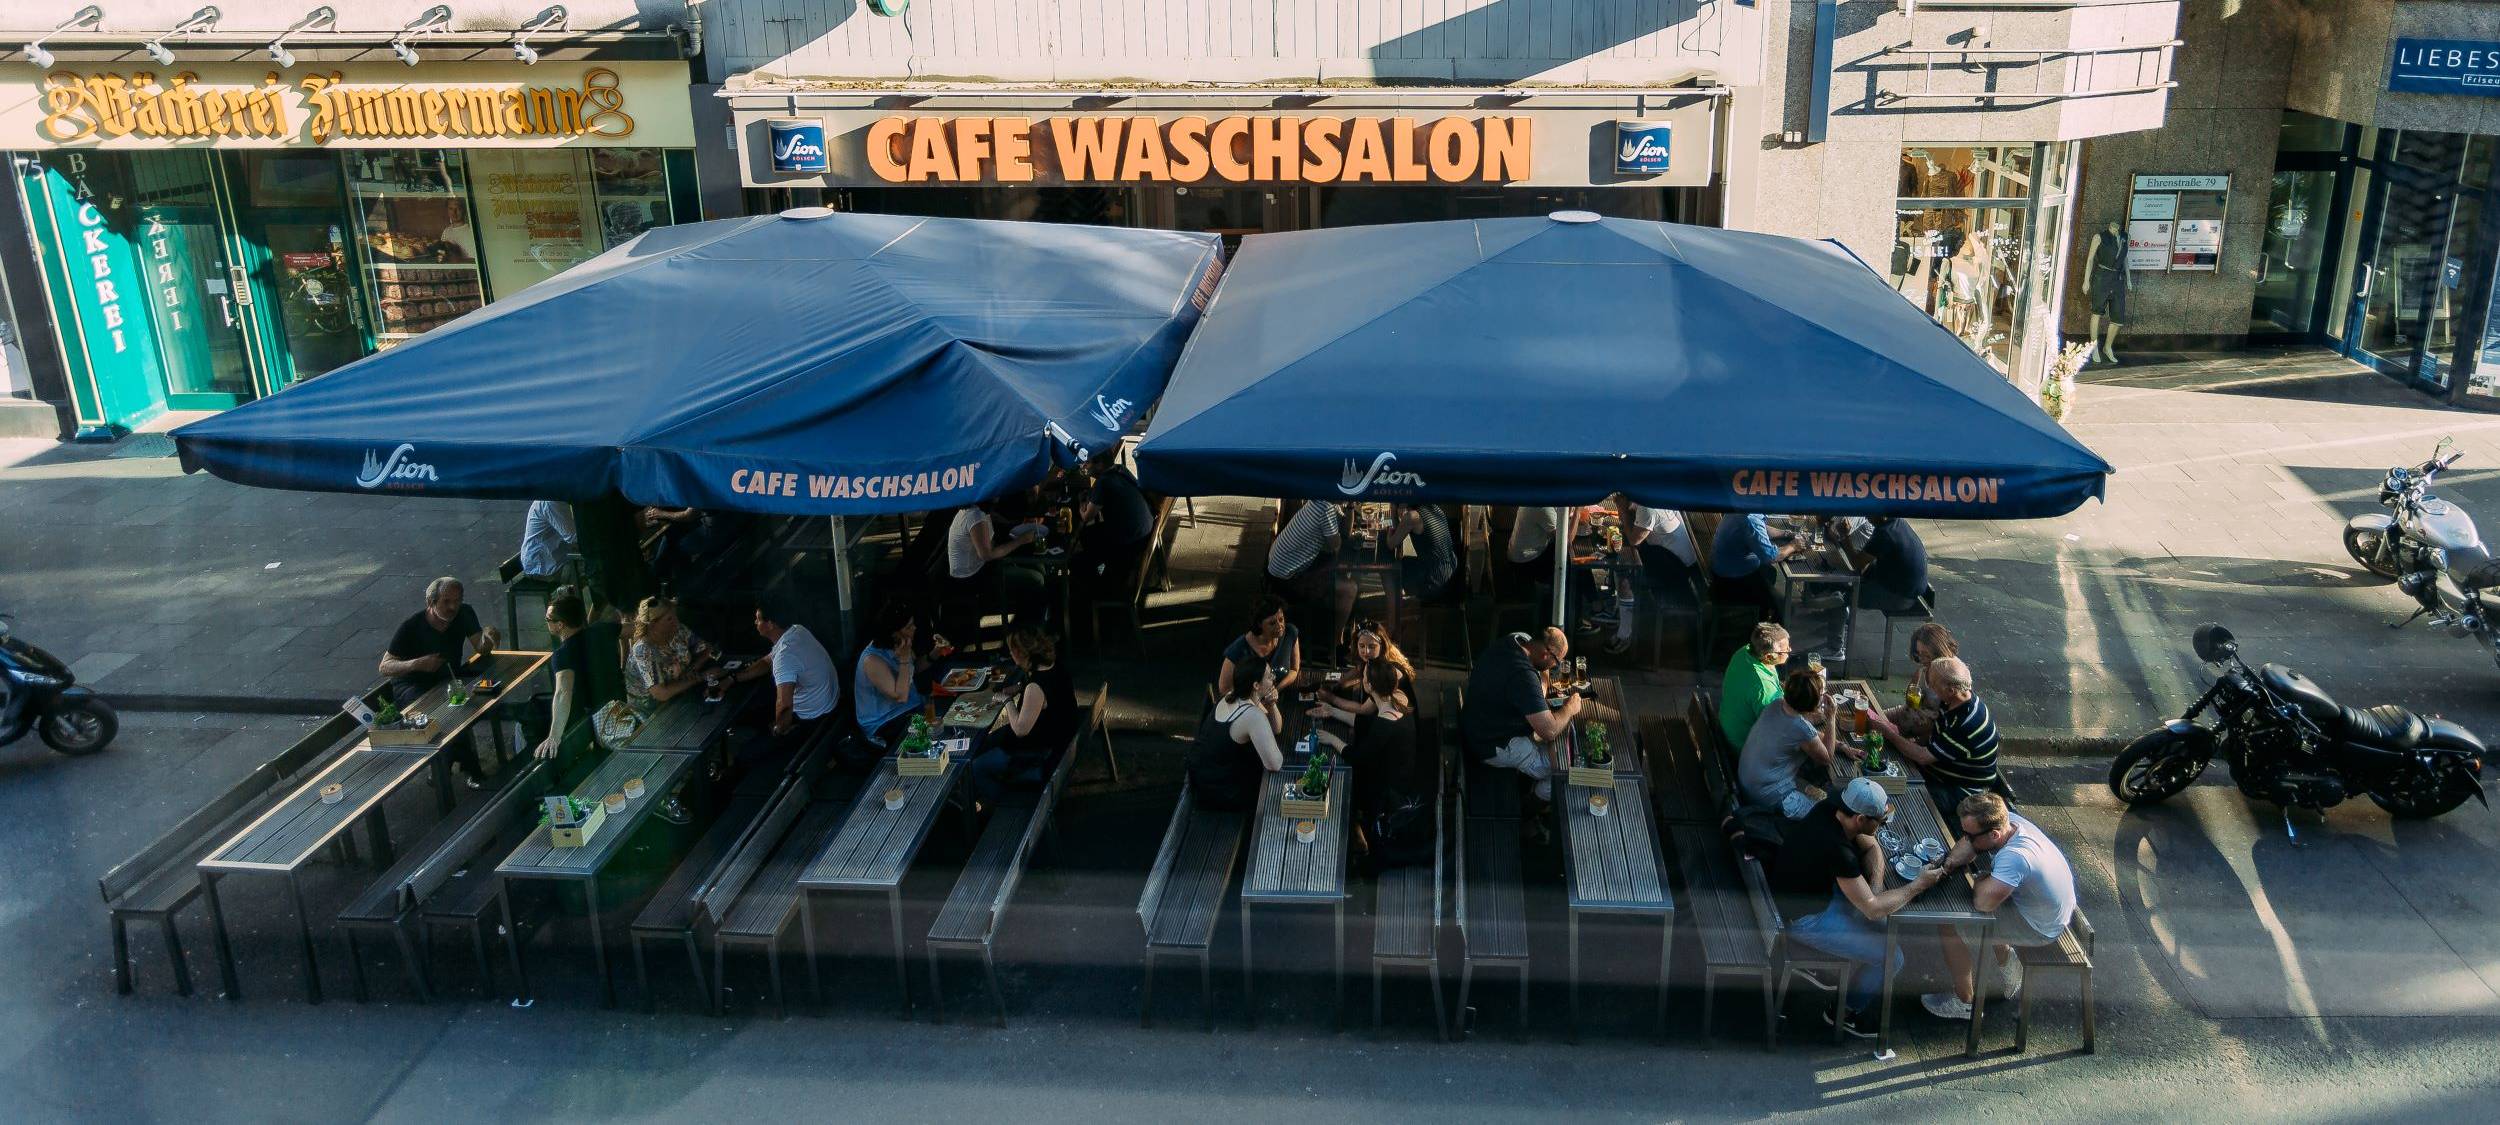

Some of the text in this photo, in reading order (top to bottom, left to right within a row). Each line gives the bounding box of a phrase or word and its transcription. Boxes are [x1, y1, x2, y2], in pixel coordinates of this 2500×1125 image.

[2400, 48, 2500, 69] LIEBES
[45, 67, 634, 144] Bäckerei Zimmermann
[774, 134, 823, 160] Sion
[867, 116, 1533, 183] CAFE WASCHSALON
[1619, 135, 1669, 162] Sion
[14, 158, 44, 180] 75
[2146, 178, 2216, 187] Ehrenstraße 79
[67, 153, 127, 354] BÄCKEREI
[1096, 394, 1133, 431] Sion
[356, 443, 440, 488] Sion
[1337, 452, 1427, 495] Sion
[731, 469, 799, 497] CAFE
[1731, 470, 1799, 496] CAFE
